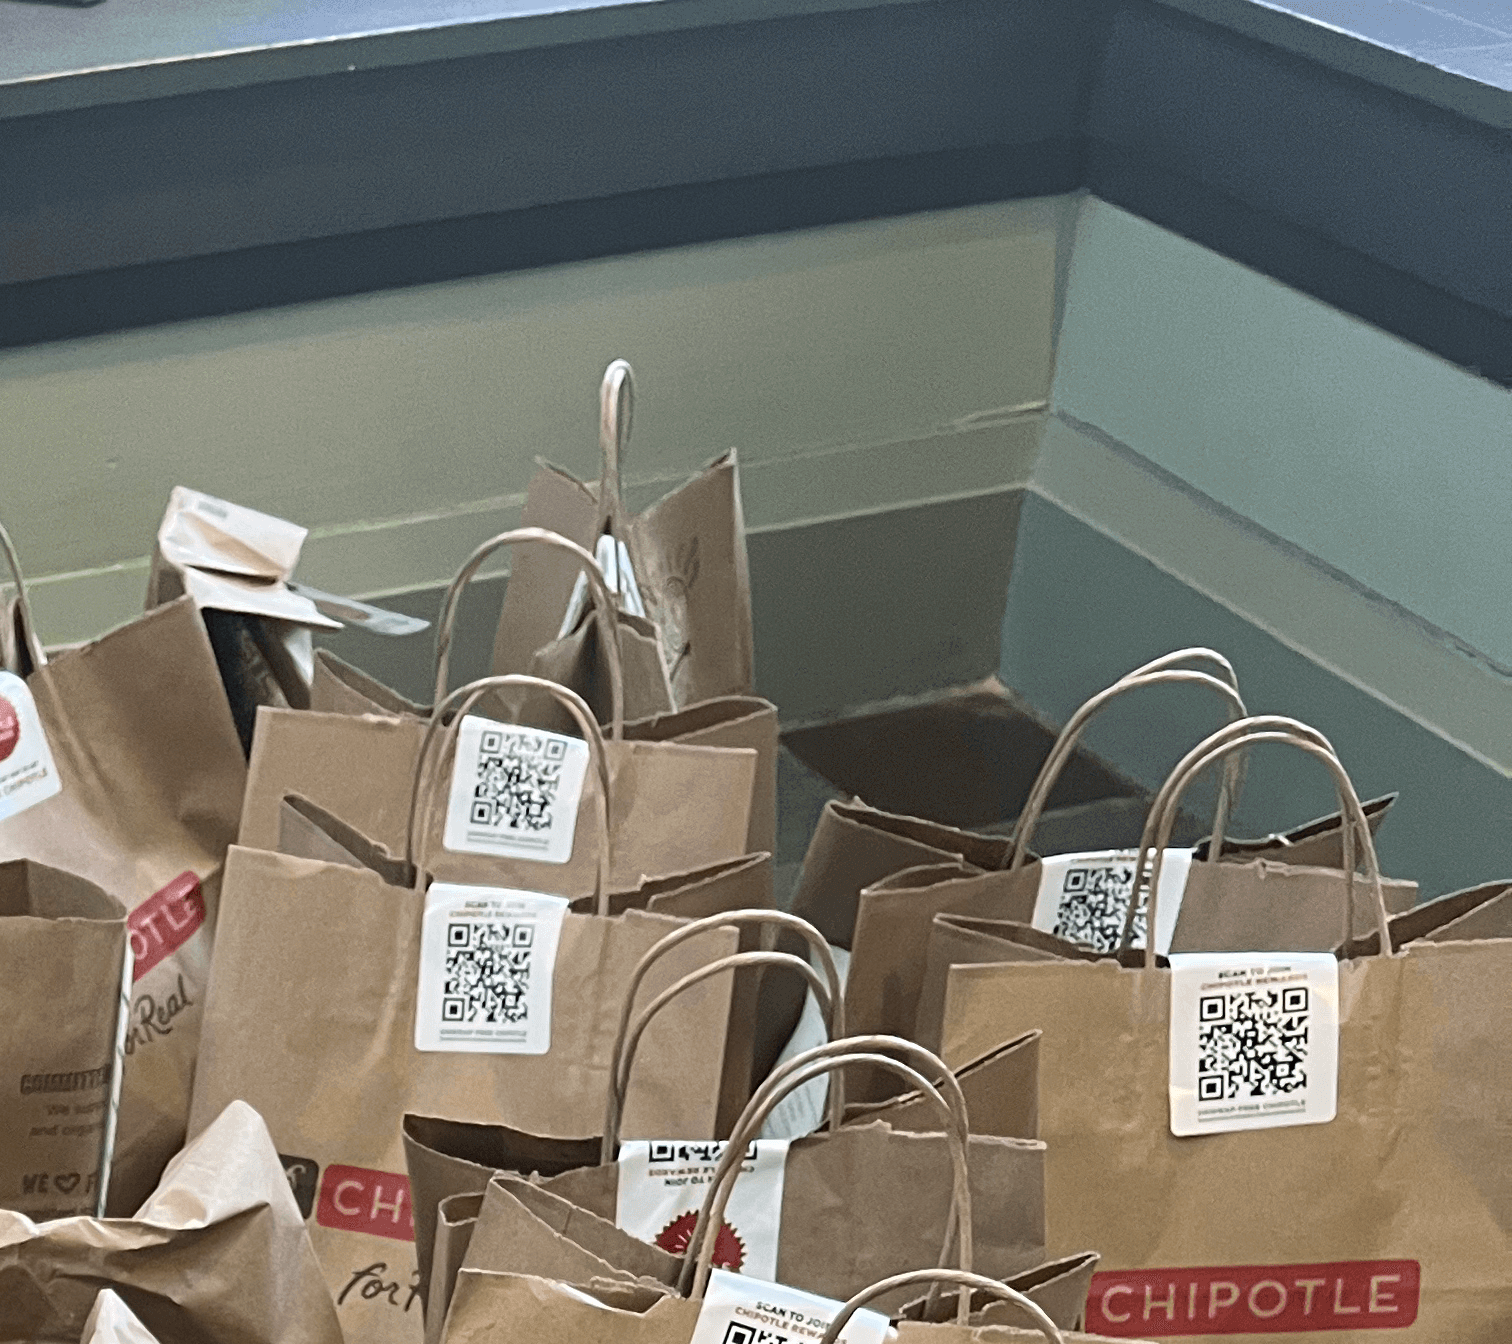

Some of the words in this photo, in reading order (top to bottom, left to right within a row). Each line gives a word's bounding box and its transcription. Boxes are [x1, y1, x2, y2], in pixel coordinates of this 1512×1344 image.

[133, 972, 195, 1043] Real
[756, 1300, 786, 1319] SCAN
[789, 1309, 805, 1323] TO
[1100, 1273, 1402, 1324] CHIPOTLE
[734, 1305, 789, 1332] CHIPOTLE
